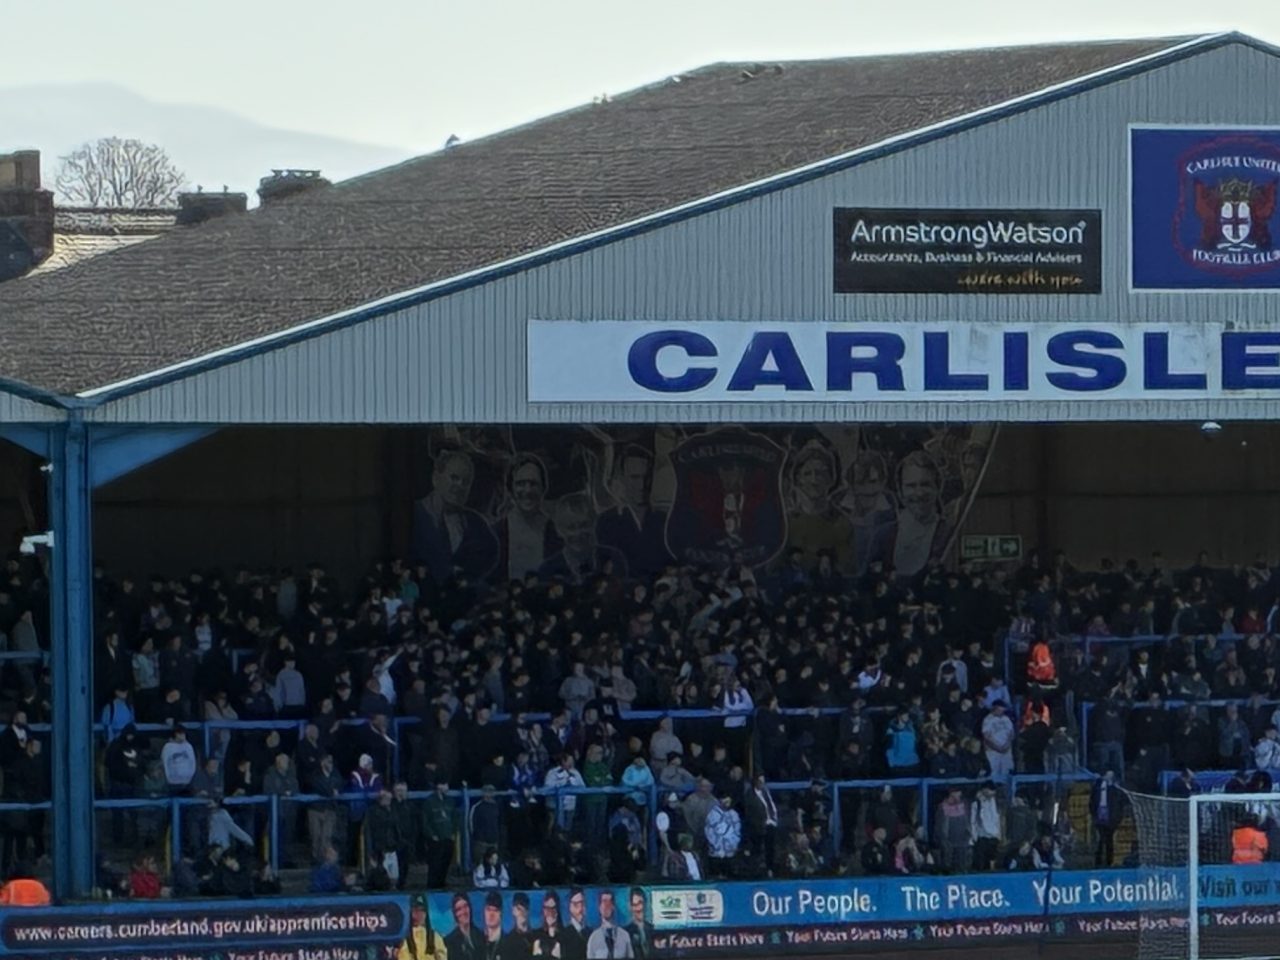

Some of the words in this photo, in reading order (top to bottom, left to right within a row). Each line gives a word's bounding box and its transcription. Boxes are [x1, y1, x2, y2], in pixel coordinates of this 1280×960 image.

[851, 219, 1083, 248] ArmstrongWatson
[753, 891, 793, 916] Our
[797, 887, 878, 922] People.
[901, 885, 940, 912] The
[947, 882, 1011, 910] Place.
[1032, 877, 1082, 906] Your
[1089, 874, 1185, 904] Potential.
[1198, 872, 1236, 897] Visit
[1242, 878, 1269, 896] our
